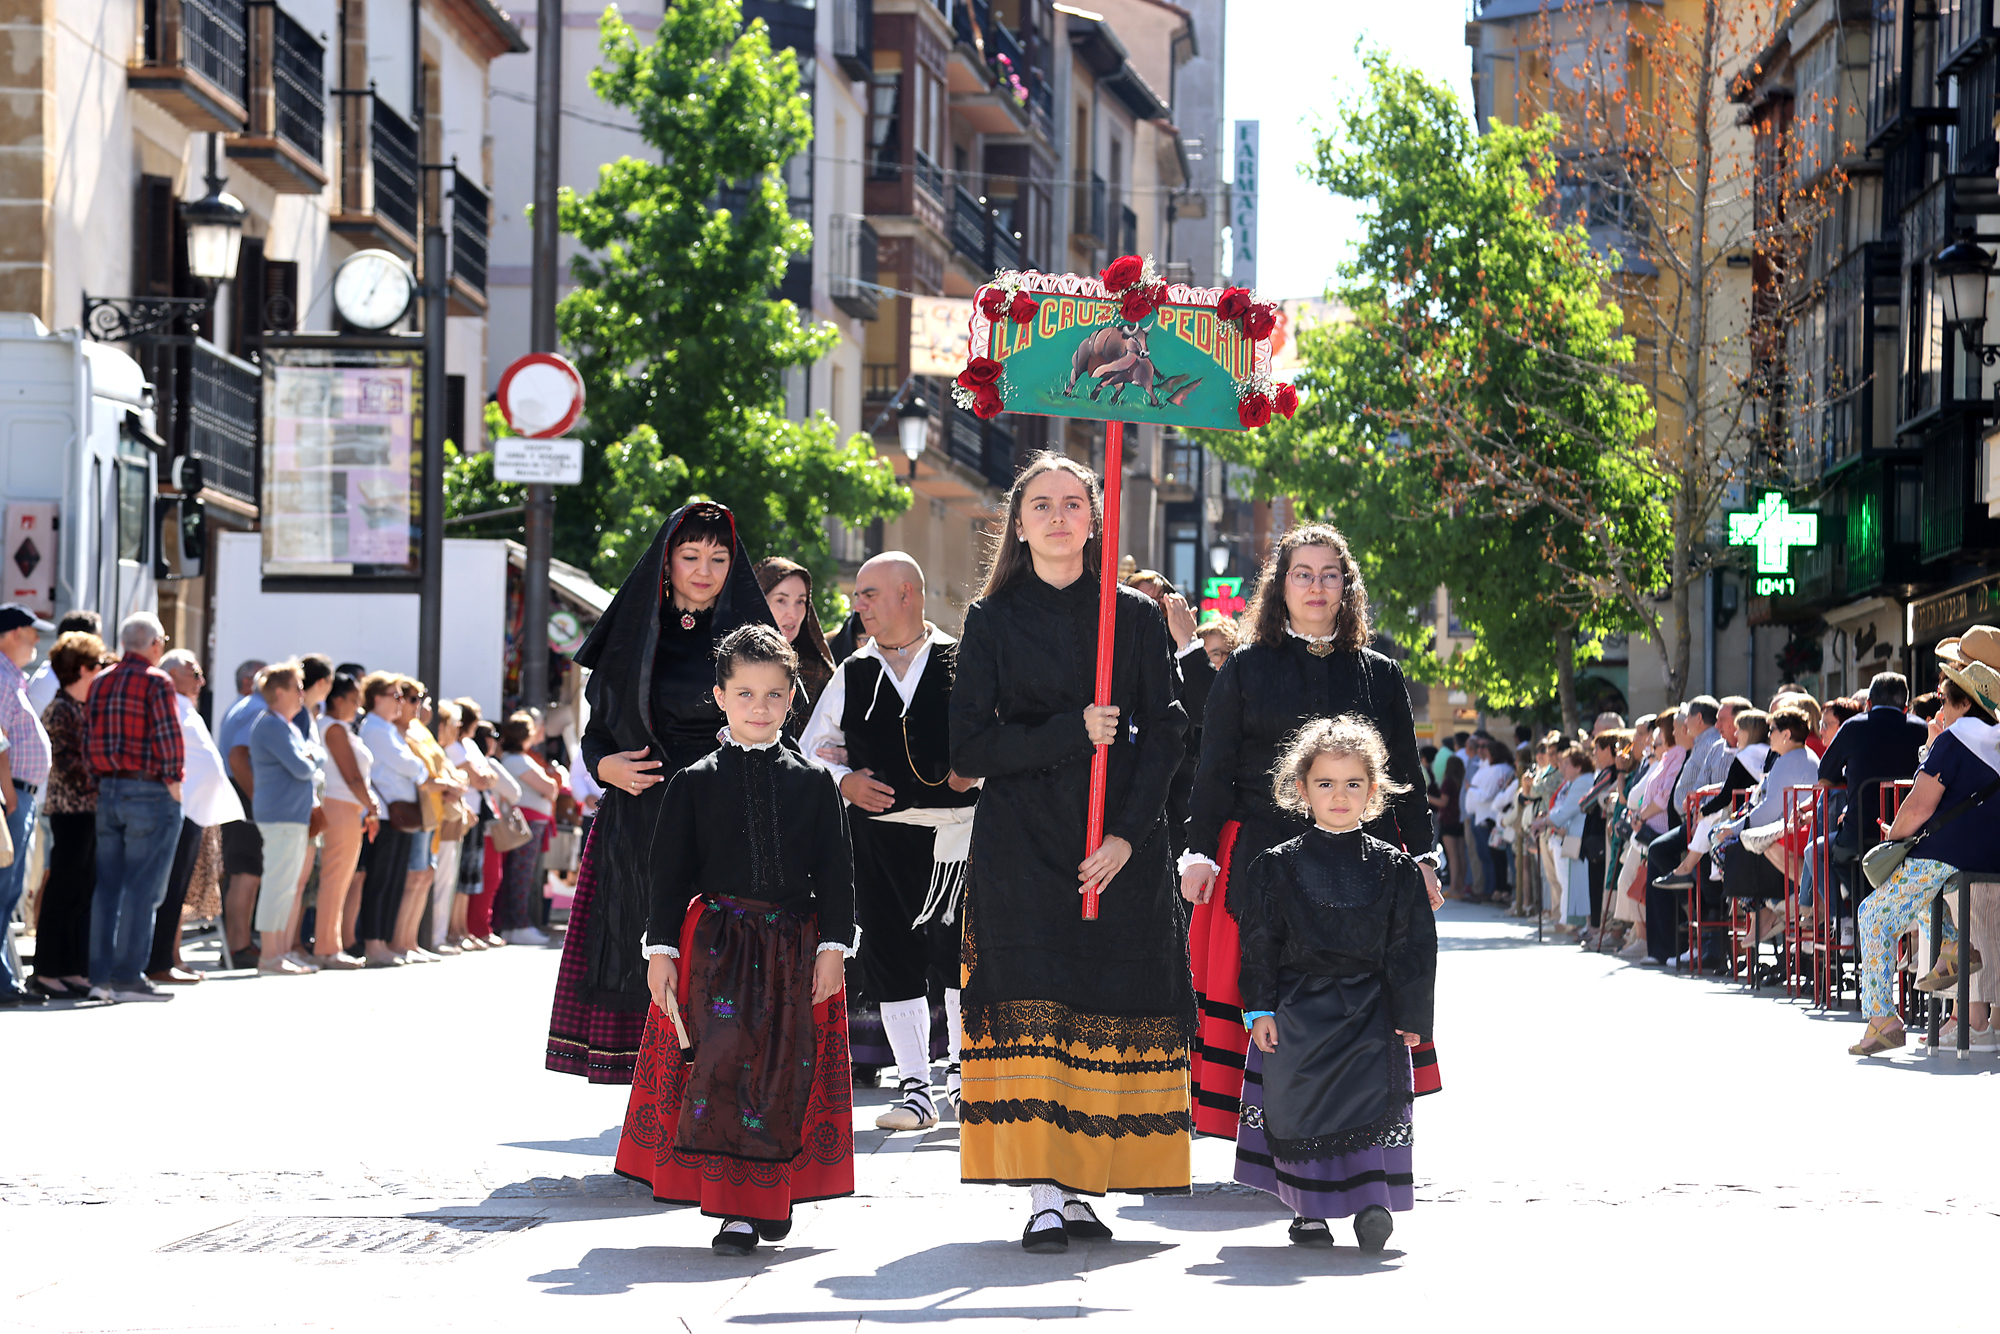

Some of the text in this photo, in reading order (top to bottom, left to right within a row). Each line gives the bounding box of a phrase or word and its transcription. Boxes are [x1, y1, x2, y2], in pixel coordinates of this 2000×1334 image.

[1237, 125, 1254, 262] FARMACIA
[994, 316, 1032, 362] LA
[1038, 298, 1115, 340] CRUZ
